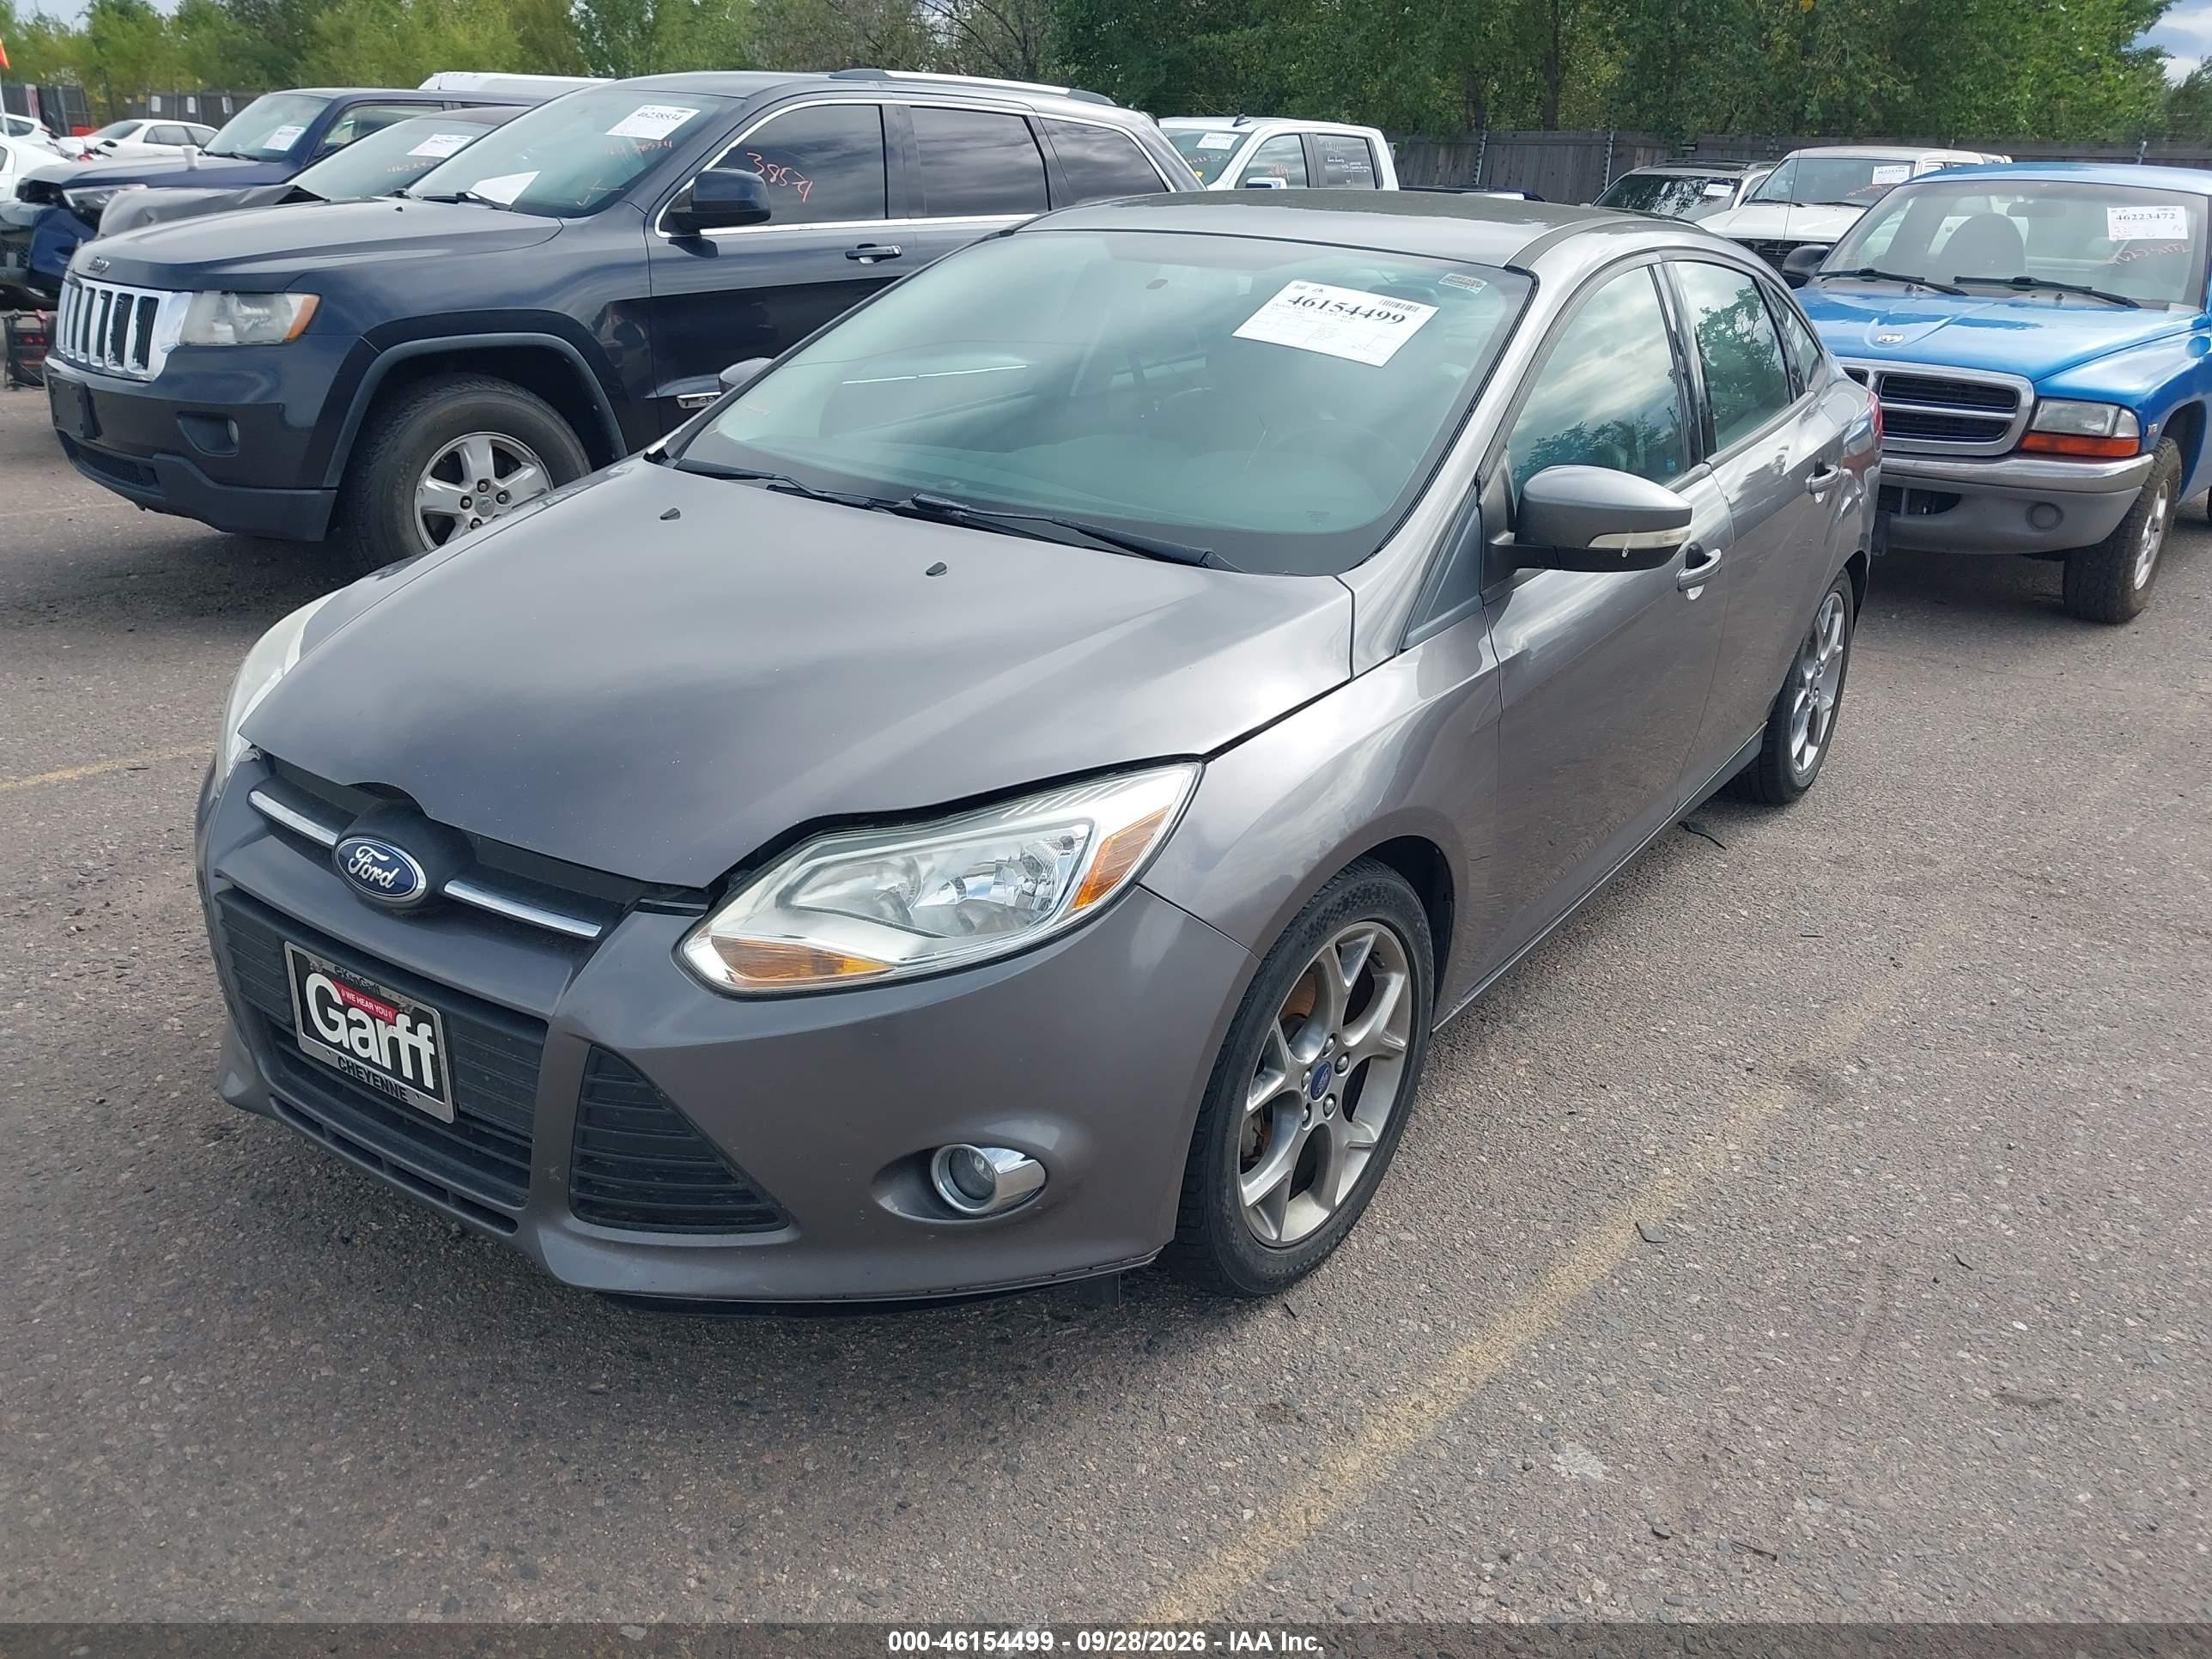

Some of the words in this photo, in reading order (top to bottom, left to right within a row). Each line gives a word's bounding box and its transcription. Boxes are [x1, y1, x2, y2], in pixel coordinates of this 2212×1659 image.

[2115, 212, 2177, 222] 46223472
[1287, 295, 1406, 325] 46154499
[348, 846, 400, 889] Ford
[345, 991, 356, 1002] WE
[356, 996, 374, 1011] HEAR
[374, 1004, 389, 1017] YOU
[306, 972, 435, 1091] Garff
[337, 1055, 409, 1102] CHEYENNE
